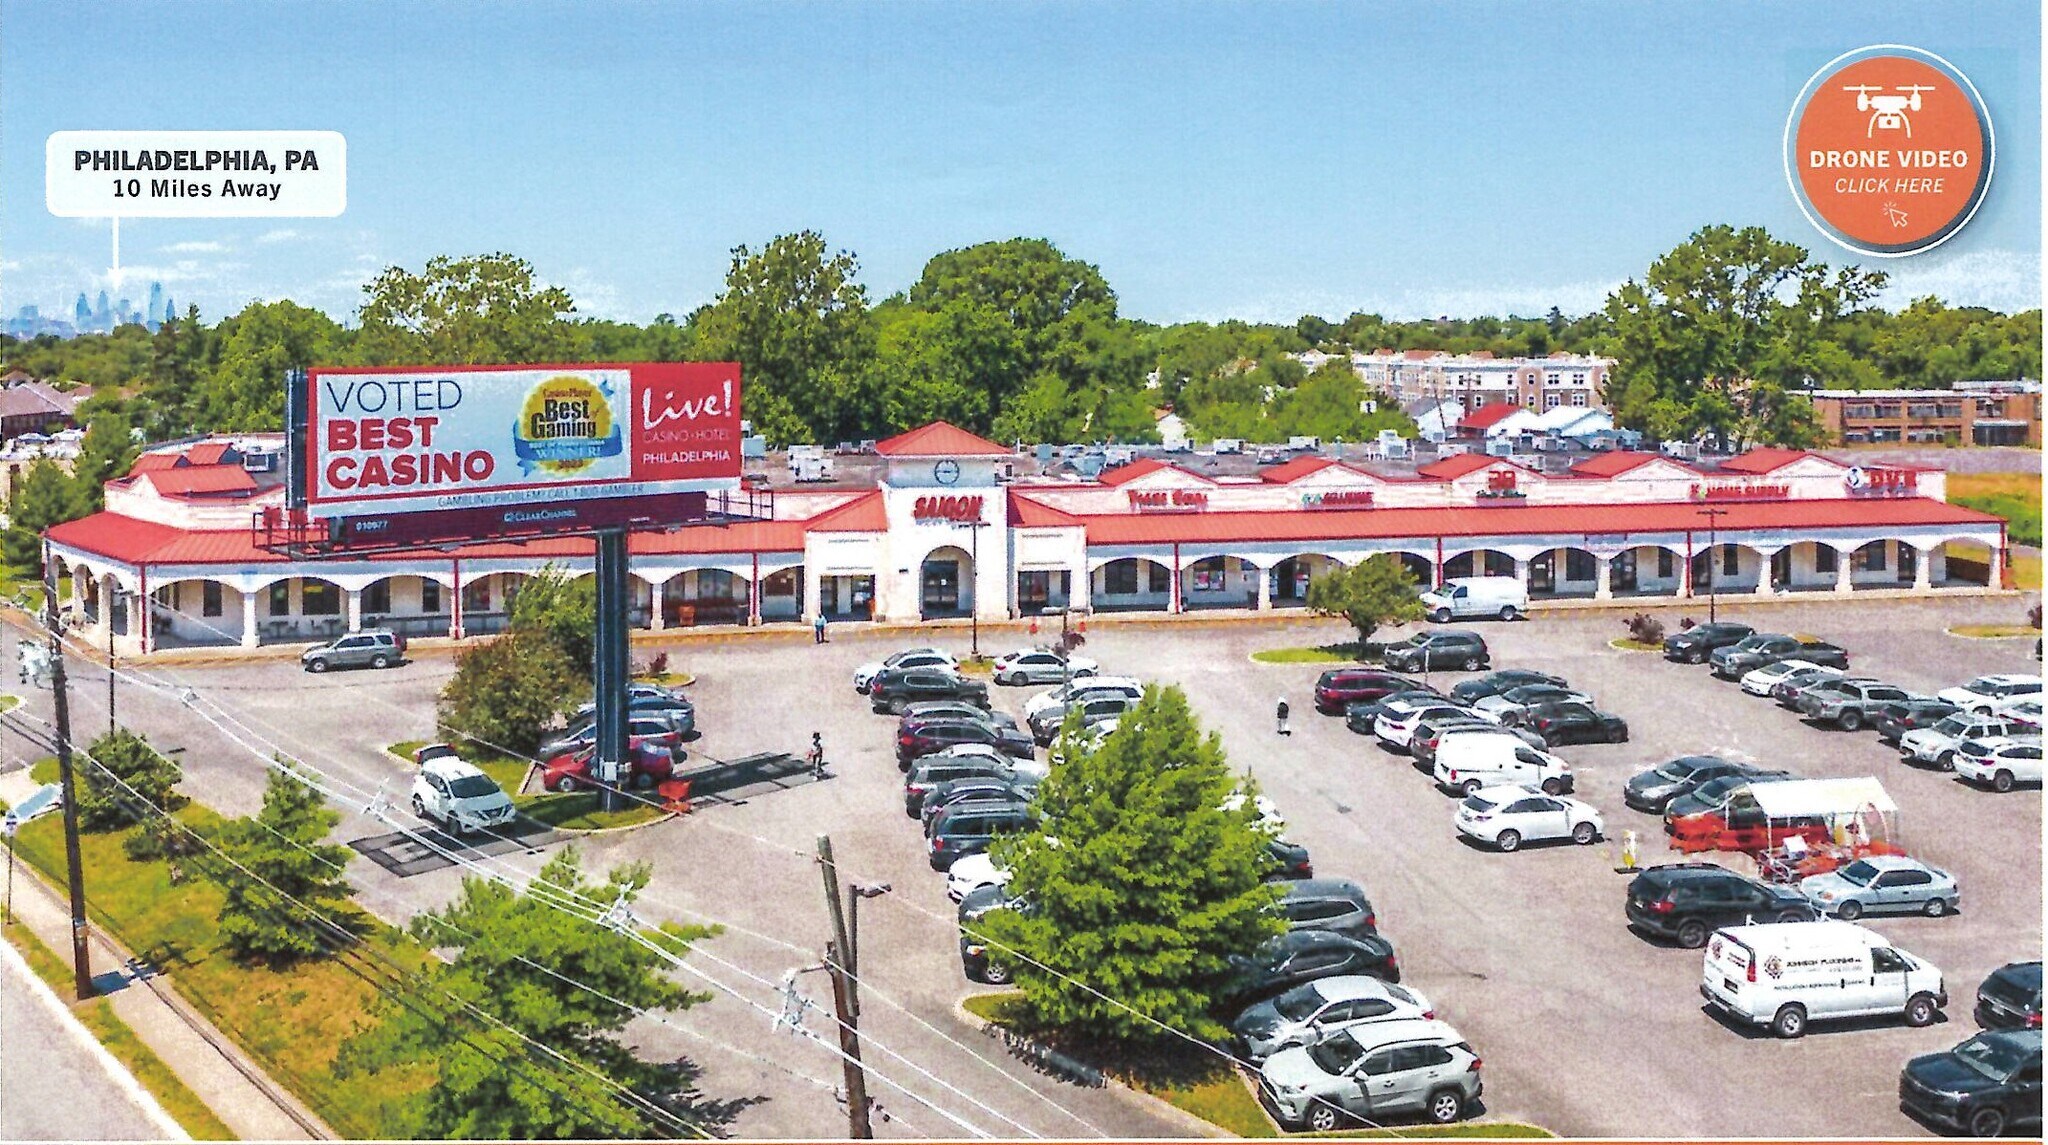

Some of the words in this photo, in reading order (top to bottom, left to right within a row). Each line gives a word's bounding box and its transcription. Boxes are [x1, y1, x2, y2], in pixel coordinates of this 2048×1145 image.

[327, 380, 462, 413] VOTED
[544, 399, 590, 422] Best
[642, 380, 732, 430] Live!
[327, 416, 438, 452] BEST
[531, 412, 596, 438] Gaming
[643, 429, 689, 443] CASINO
[696, 428, 730, 441] HOTEL
[326, 450, 495, 490] CASINO
[643, 449, 731, 464] PHILADELPHIA
